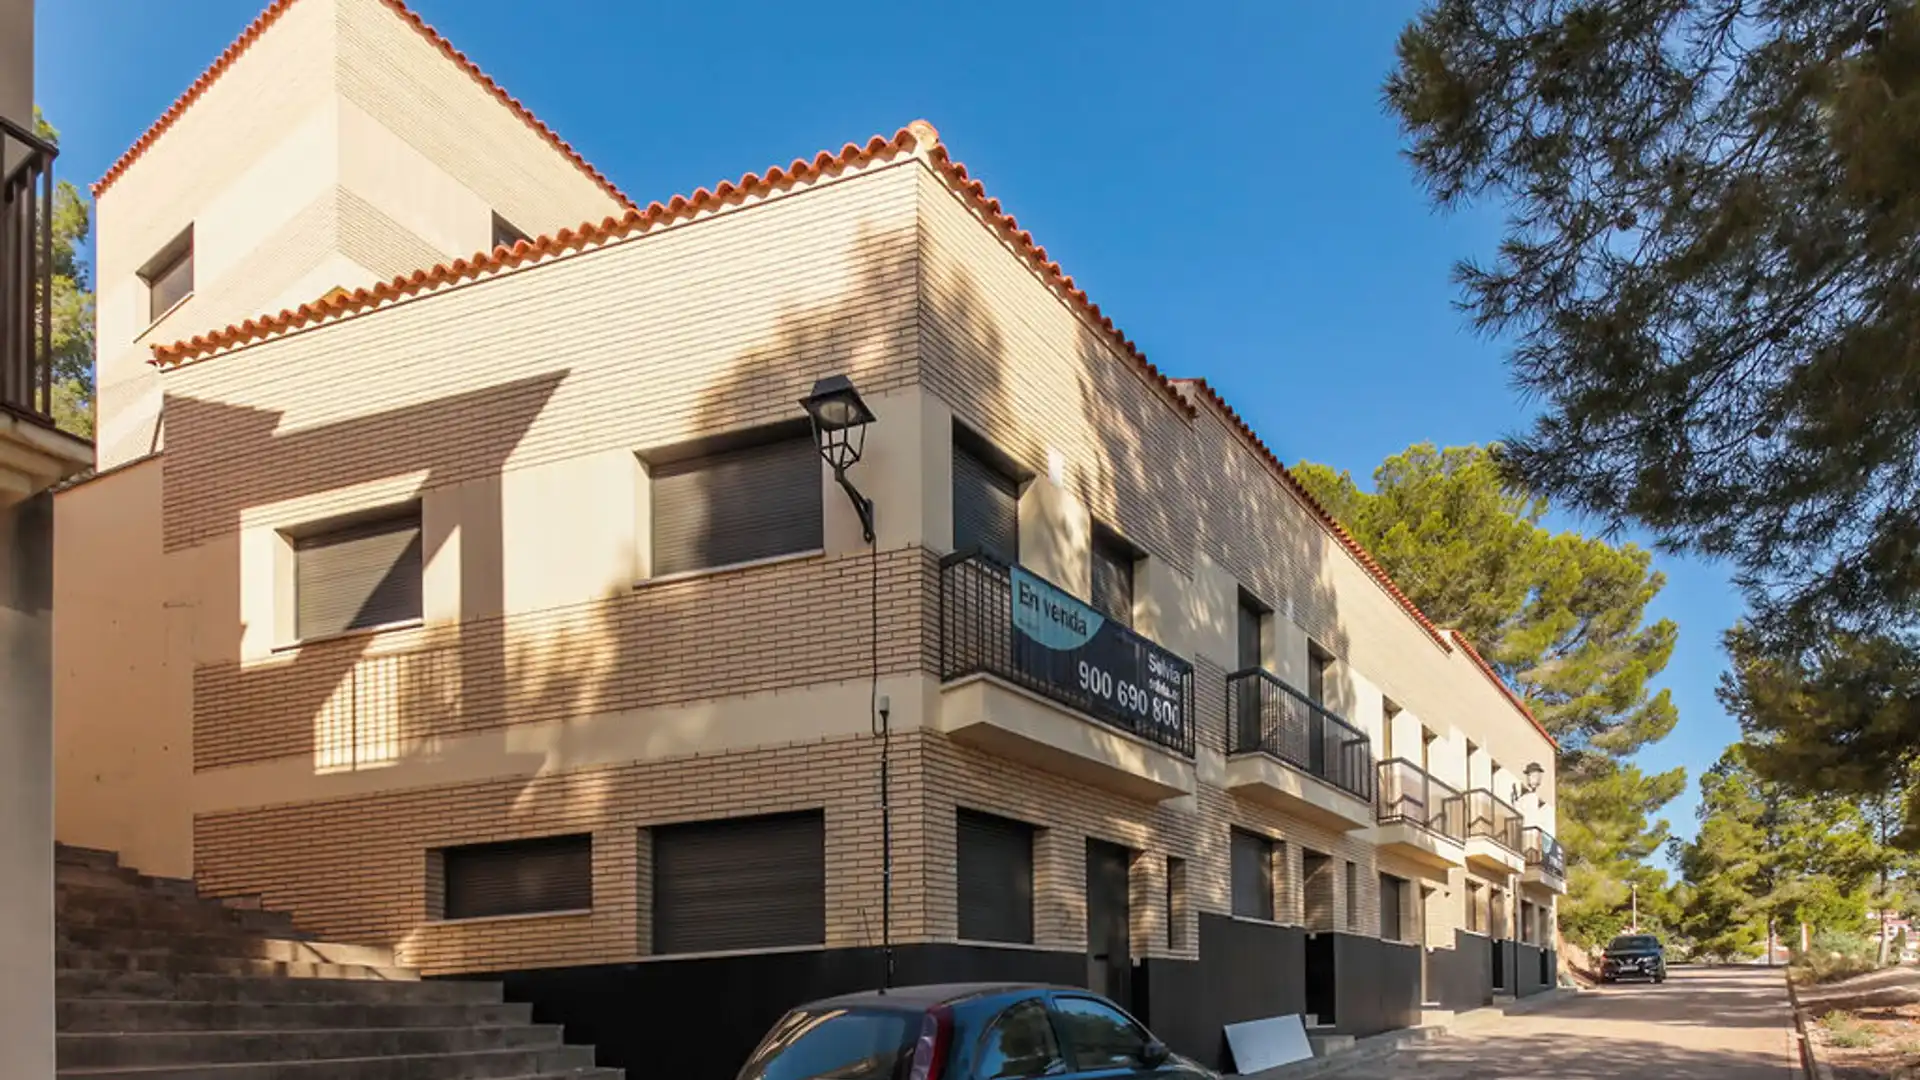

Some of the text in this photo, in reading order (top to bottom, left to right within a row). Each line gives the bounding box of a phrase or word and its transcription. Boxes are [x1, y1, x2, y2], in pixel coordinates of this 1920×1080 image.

[1019, 580, 1038, 611] En
[1043, 598, 1087, 636] venda
[1079, 660, 1112, 699] 900
[1117, 680, 1148, 716] 690
[1152, 697, 1180, 730] 800
